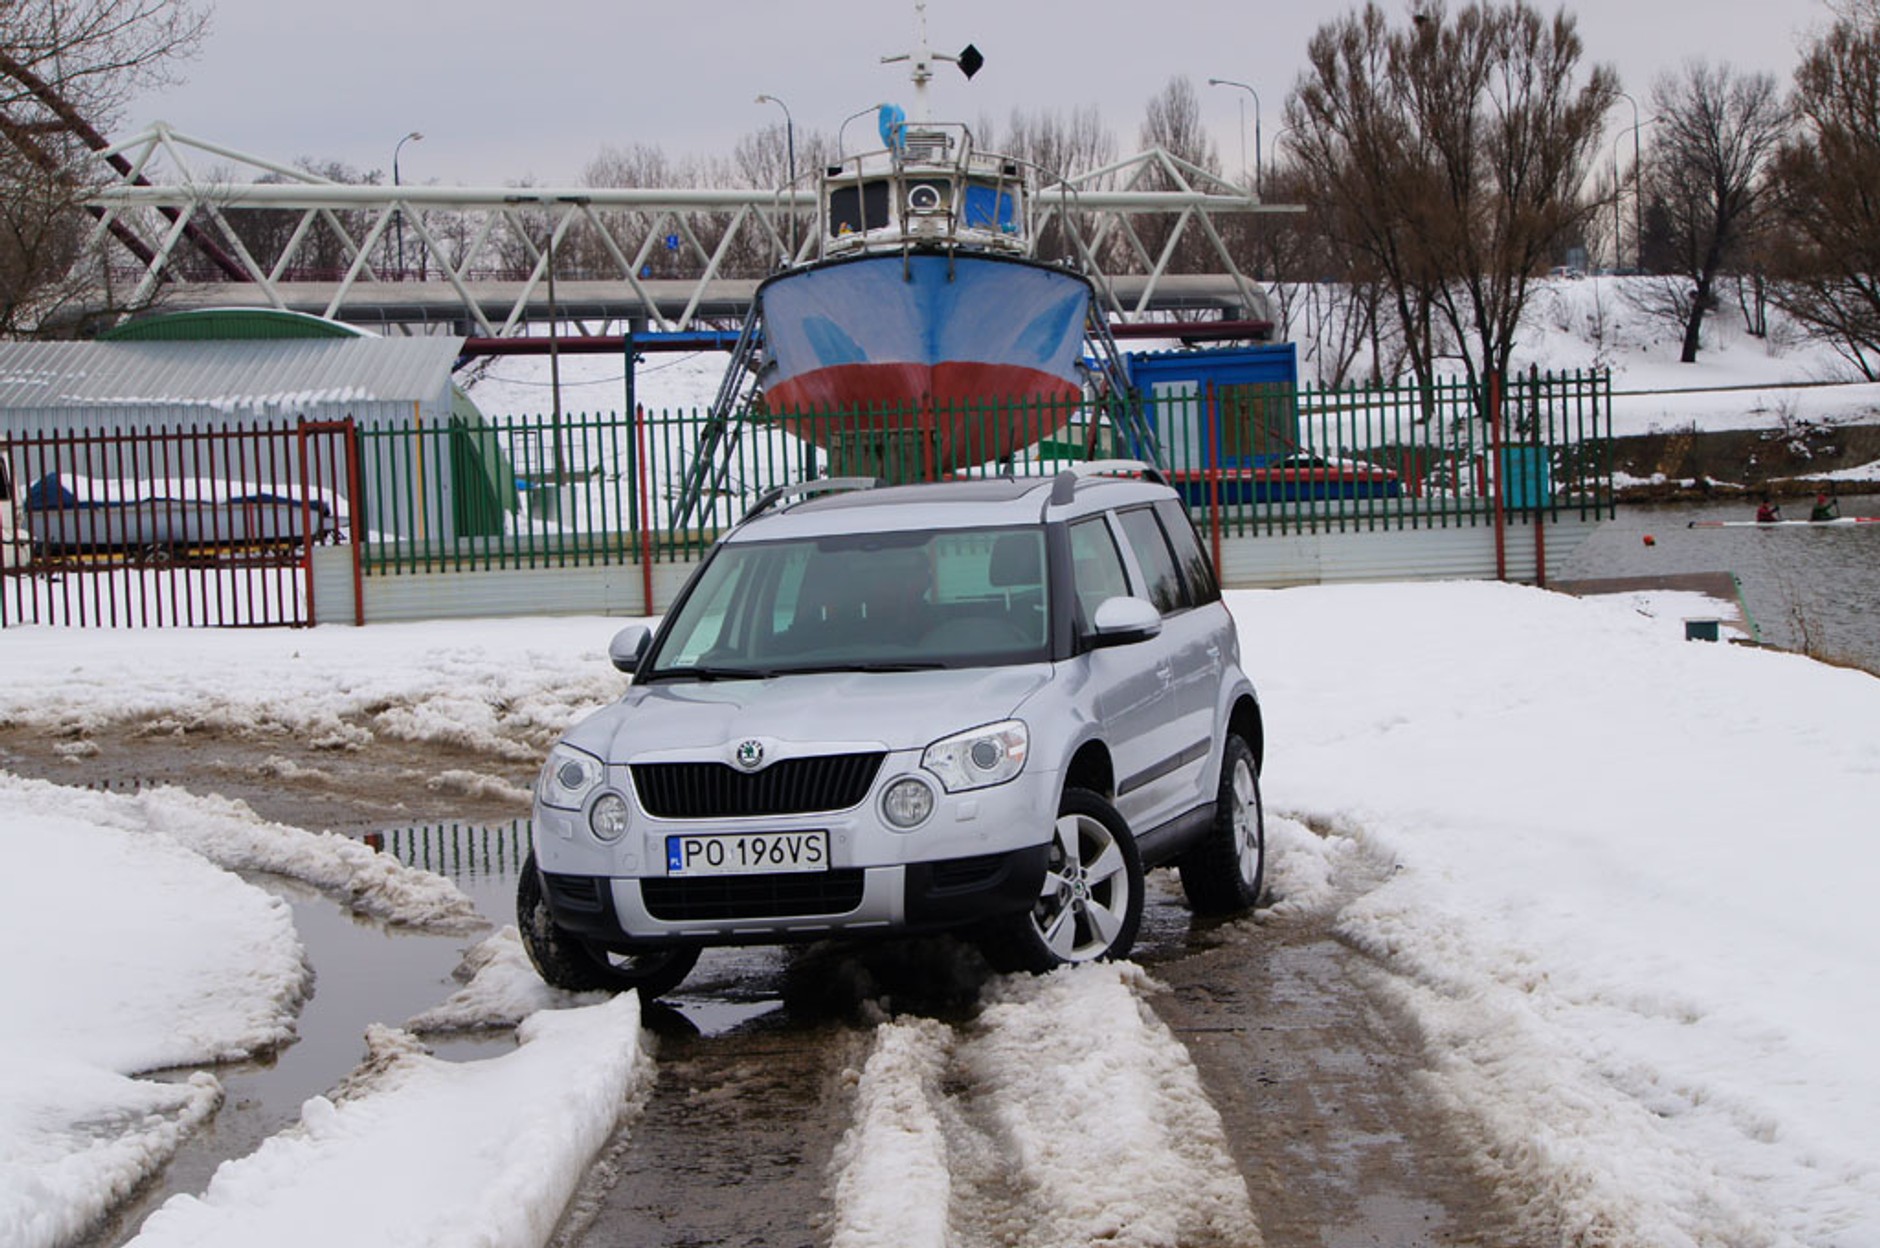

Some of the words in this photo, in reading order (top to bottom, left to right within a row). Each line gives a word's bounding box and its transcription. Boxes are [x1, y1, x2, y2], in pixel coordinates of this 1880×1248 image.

[685, 839, 724, 867] PO
[737, 835, 823, 865] 196VS
[670, 858, 681, 866] PL
